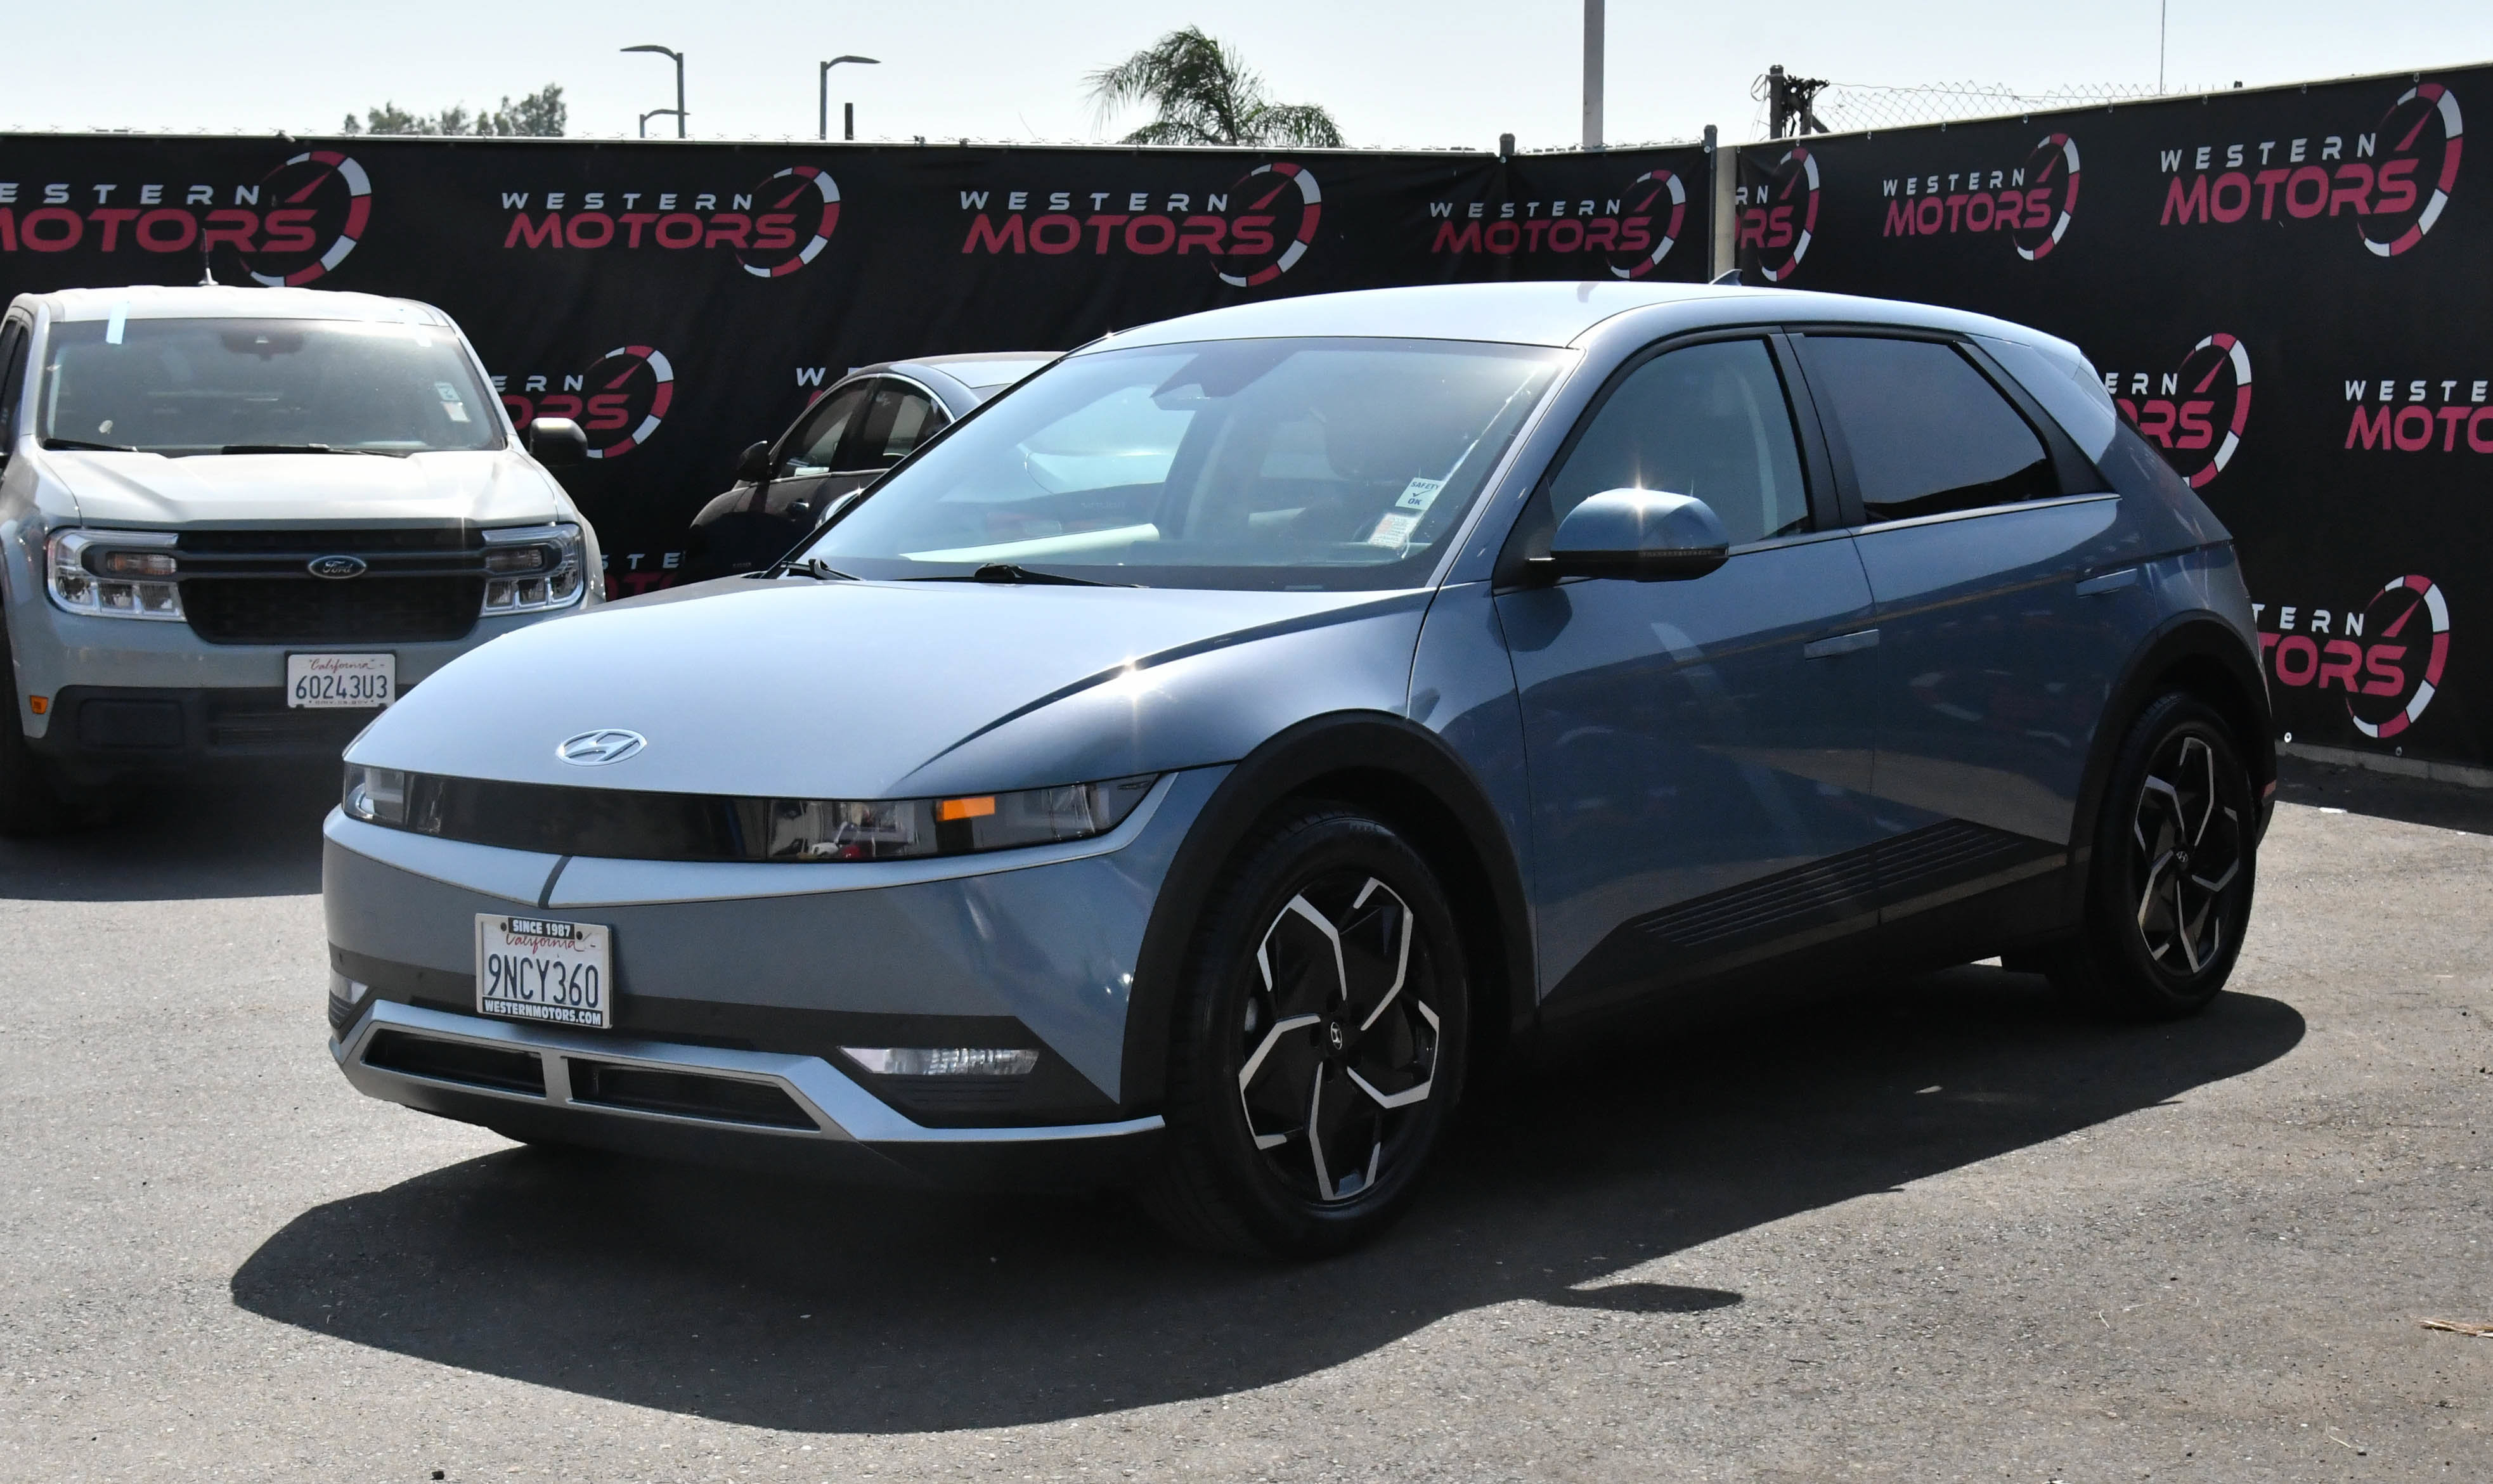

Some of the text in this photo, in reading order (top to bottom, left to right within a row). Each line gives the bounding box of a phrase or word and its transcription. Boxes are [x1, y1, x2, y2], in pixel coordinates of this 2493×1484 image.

[2161, 132, 2376, 173] WESTERN
[0, 183, 259, 205] ESTERN
[1883, 168, 2025, 197] WESTERN
[2160, 158, 2419, 226] MOTORS
[502, 192, 752, 210] WESTERN
[961, 191, 1228, 212] WESTERN
[1430, 199, 1621, 218] WESTERN
[1884, 188, 2052, 236] MOTORS
[504, 212, 797, 249] MOTORS
[963, 214, 1276, 255] MOTORS
[1431, 216, 1652, 254] MOTORS
[1735, 205, 1794, 249] RS
[2345, 380, 2489, 403] WESTE
[1411, 481, 1439, 490] SAFETY
[323, 560, 353, 573] Ford
[311, 659, 375, 674] California
[295, 675, 387, 699] 60243U3
[512, 919, 571, 937] SINCE 1987
[488, 953, 599, 1008] 9NCY360
[485, 1000, 601, 1025] WESTERNMOTORS.COM
